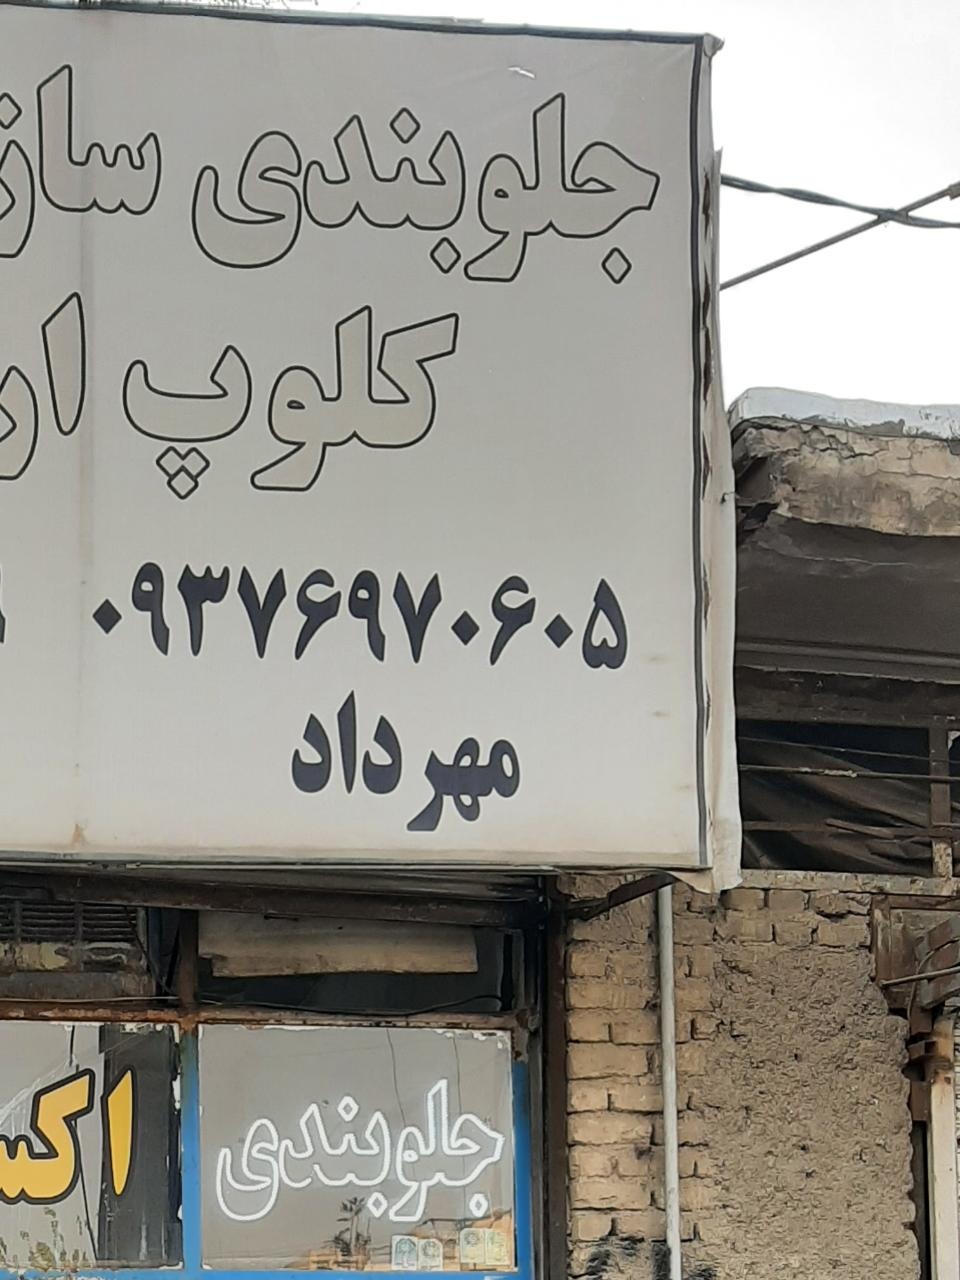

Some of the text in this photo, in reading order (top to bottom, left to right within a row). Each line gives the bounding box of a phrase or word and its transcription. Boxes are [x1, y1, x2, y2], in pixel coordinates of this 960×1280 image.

[192, 92, 660, 284] جلوبندی
[123, 305, 459, 499] کلوپ
[92, 561, 629, 670] ۰۹۳۷۶۹۷۰۶۰۵
[291, 690, 522, 832] مهرداد
[216, 1077, 506, 1222] جلوبندی
